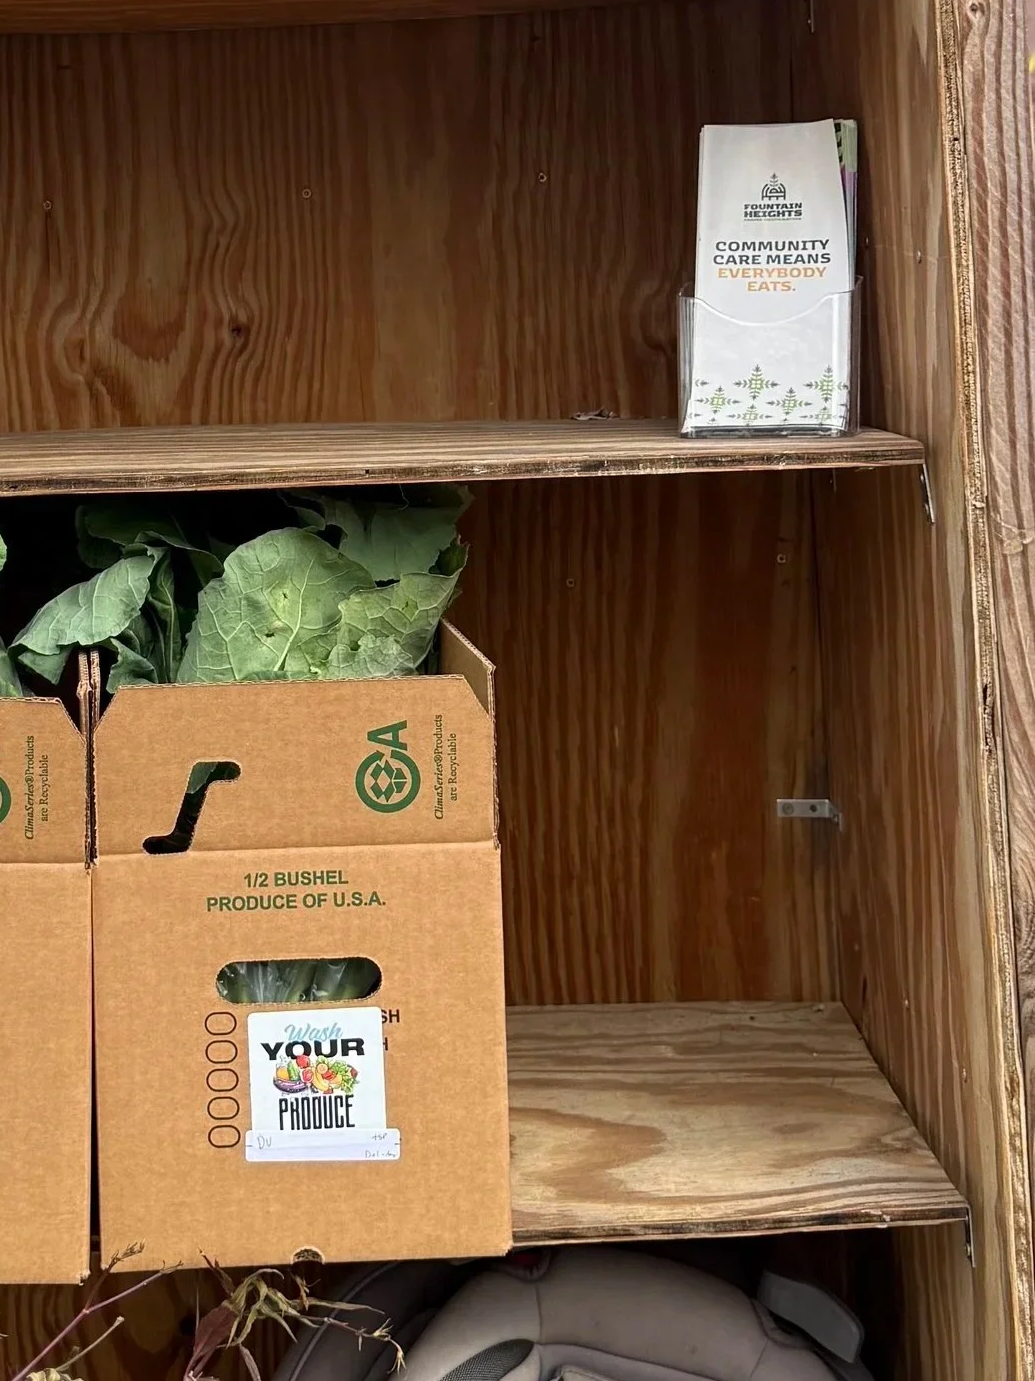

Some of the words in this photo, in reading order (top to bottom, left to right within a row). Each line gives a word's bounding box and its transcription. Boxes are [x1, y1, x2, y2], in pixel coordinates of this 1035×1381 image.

[744, 202, 803, 210] FOUNTAIN
[744, 210, 803, 218] HEIGHTS
[715, 239, 830, 252] COMMUNITY
[713, 254, 762, 266] CARE
[766, 253, 831, 265] MEANS
[718, 267, 827, 279] EVERYBODY
[747, 281, 796, 293] EATS.
[447, 732, 459, 783] Recyclable
[39, 754, 50, 804] Recyclable
[450, 785, 458, 802] are
[243, 872, 269, 888] 1/2
[274, 870, 349, 887] BUSHEL
[206, 895, 298, 912] PRODUCE
[302, 893, 327, 909] OF
[332, 891, 386, 908] U.S.A.
[284, 1022, 343, 1042] Wash
[261, 1038, 365, 1061] YOUR
[278, 1095, 356, 1131] PRODUCE
